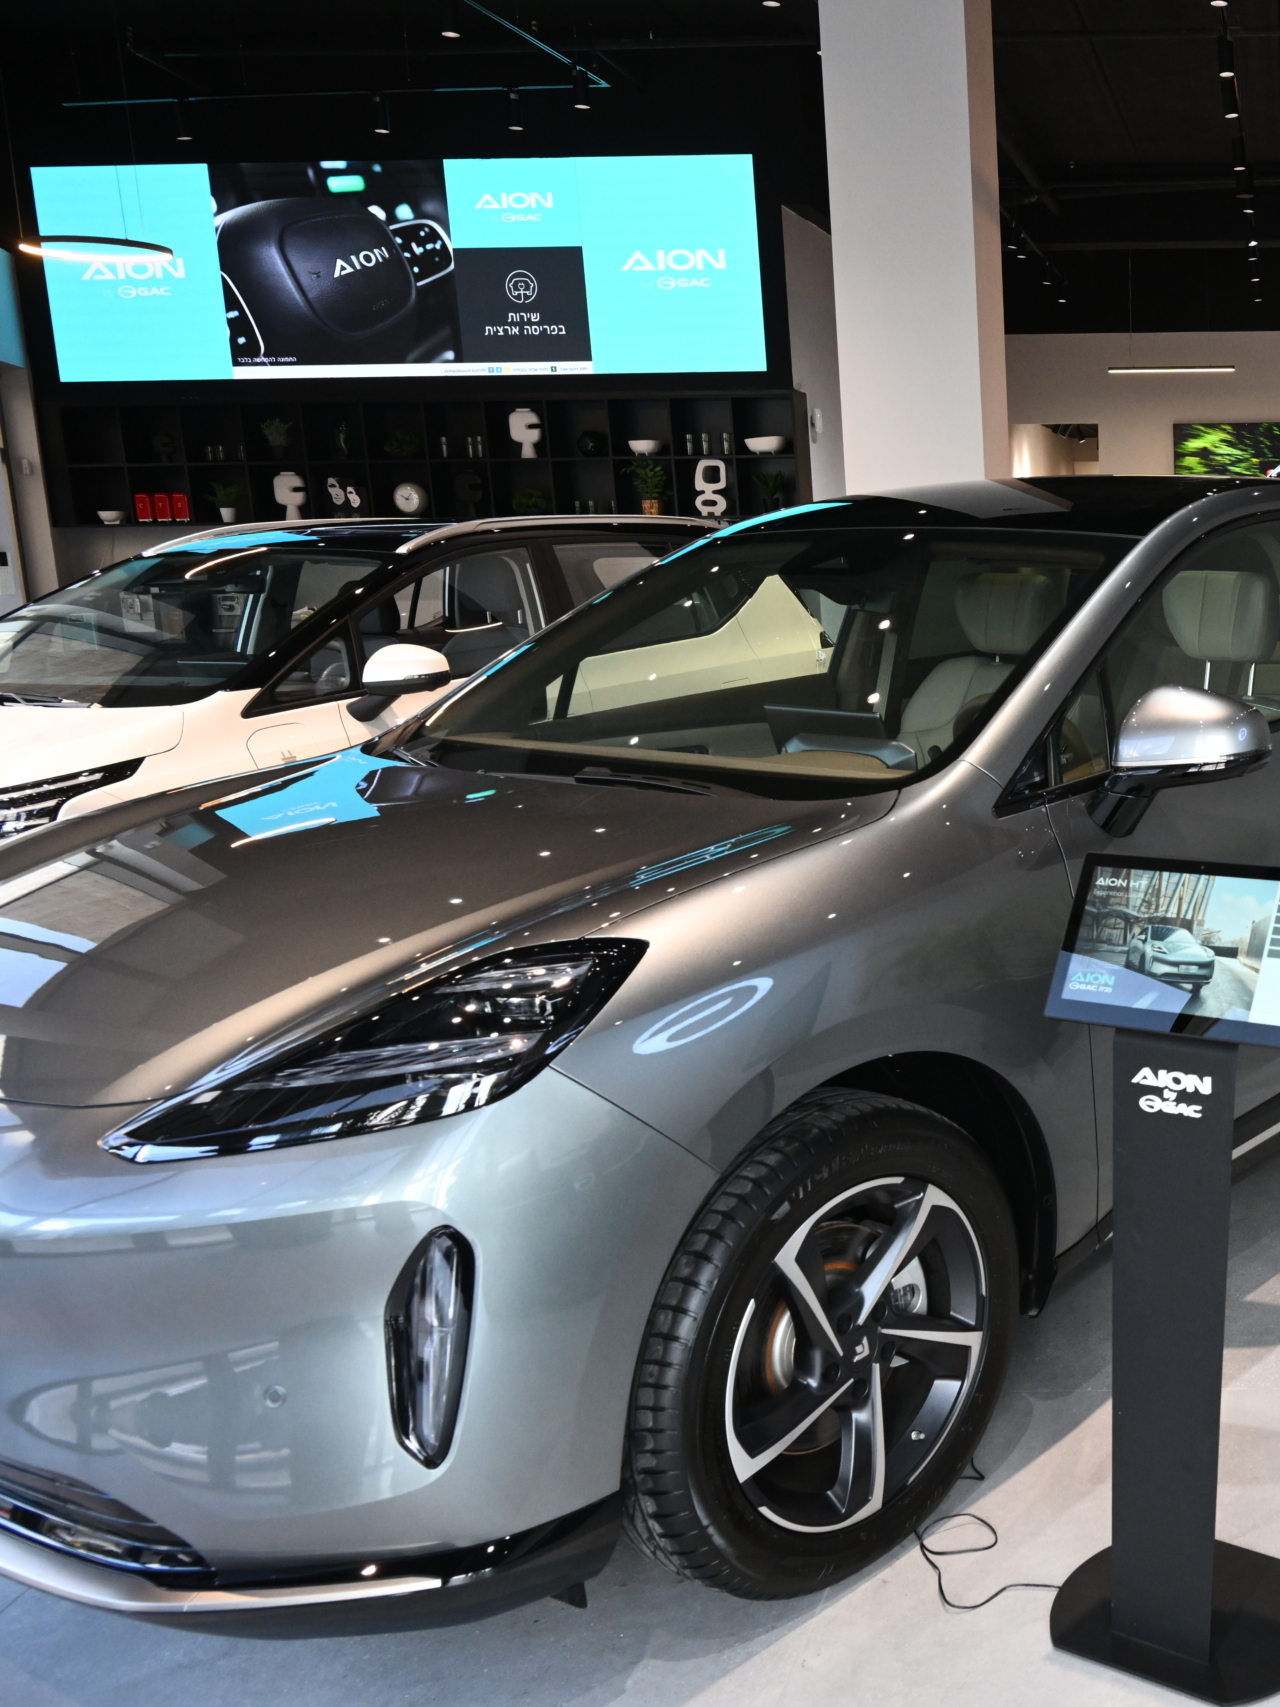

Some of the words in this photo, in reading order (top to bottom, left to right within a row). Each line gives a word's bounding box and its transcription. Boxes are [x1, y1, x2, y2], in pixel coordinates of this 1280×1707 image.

[474, 192, 553, 209] AION
[333, 246, 389, 278] AION
[620, 249, 727, 271] AION
[81, 257, 186, 280] AION
[677, 278, 711, 287] GAC
[137, 286, 171, 296] GAC
[507, 312, 540, 322] שירות
[485, 326, 520, 336] ארצית
[523, 325, 566, 335] בפריסה
[1095, 877, 1128, 887] AION
[1130, 880, 1148, 888] HT
[1071, 972, 1115, 985] AION
[1131, 1066, 1212, 1095] AION
[1163, 1088, 1177, 1101] by
[1161, 1100, 1202, 1118] GAC
